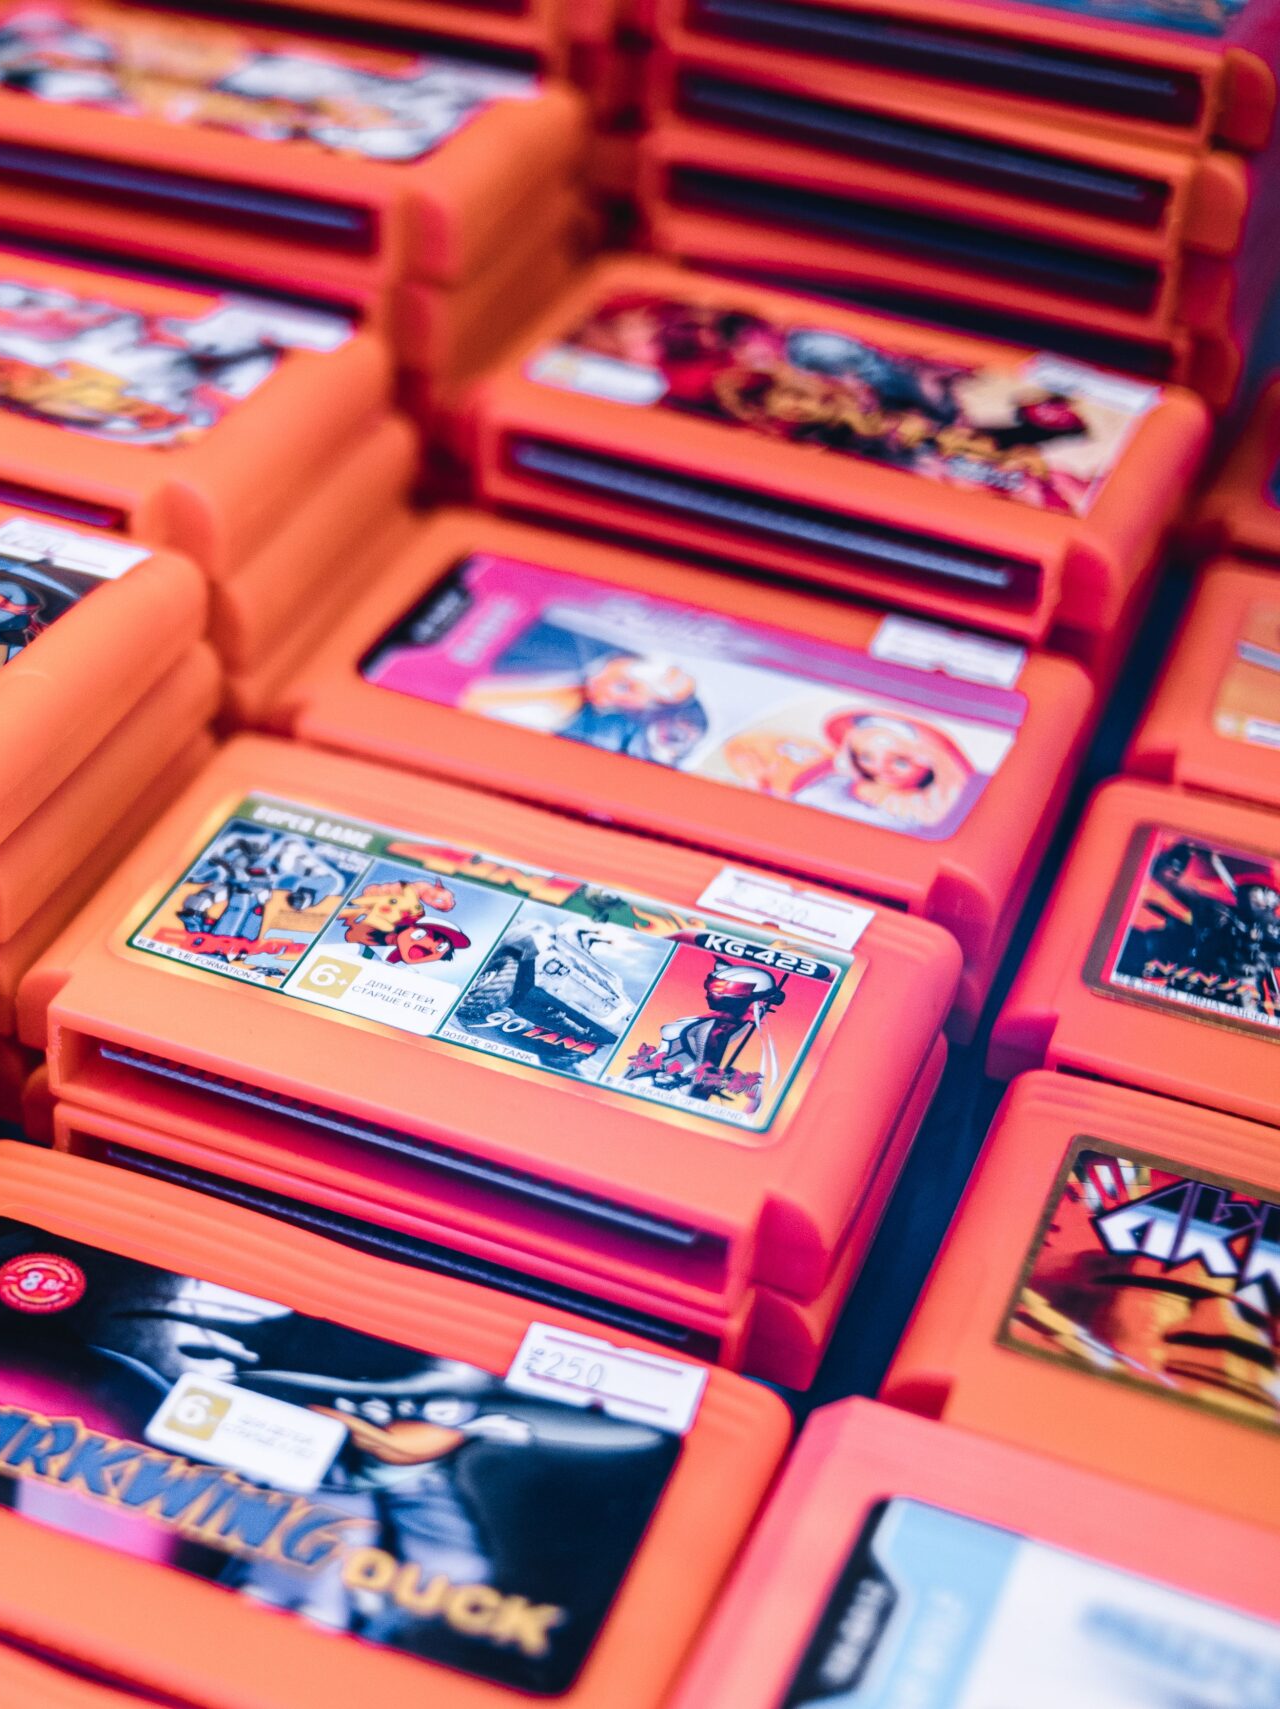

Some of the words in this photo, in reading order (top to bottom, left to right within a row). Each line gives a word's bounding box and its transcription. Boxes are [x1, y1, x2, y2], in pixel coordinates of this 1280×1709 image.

[704, 933, 819, 977] KG-423
[308, 963, 349, 988] 6+
[351, 985, 401, 1006] СТАРШЕ
[403, 1001, 411, 1010] 6
[412, 1004, 439, 1017] ЛЕТ
[365, 979, 393, 992] ДЛЯ
[393, 987, 436, 1005] ДЕТЕЙ
[468, 1011, 528, 1033] 90
[482, 1041, 501, 1051] 90
[500, 1046, 535, 1063] TANK
[20, 1271, 44, 1291] 8
[543, 1351, 605, 1388] 250
[342, 1547, 568, 1656] DUCK
